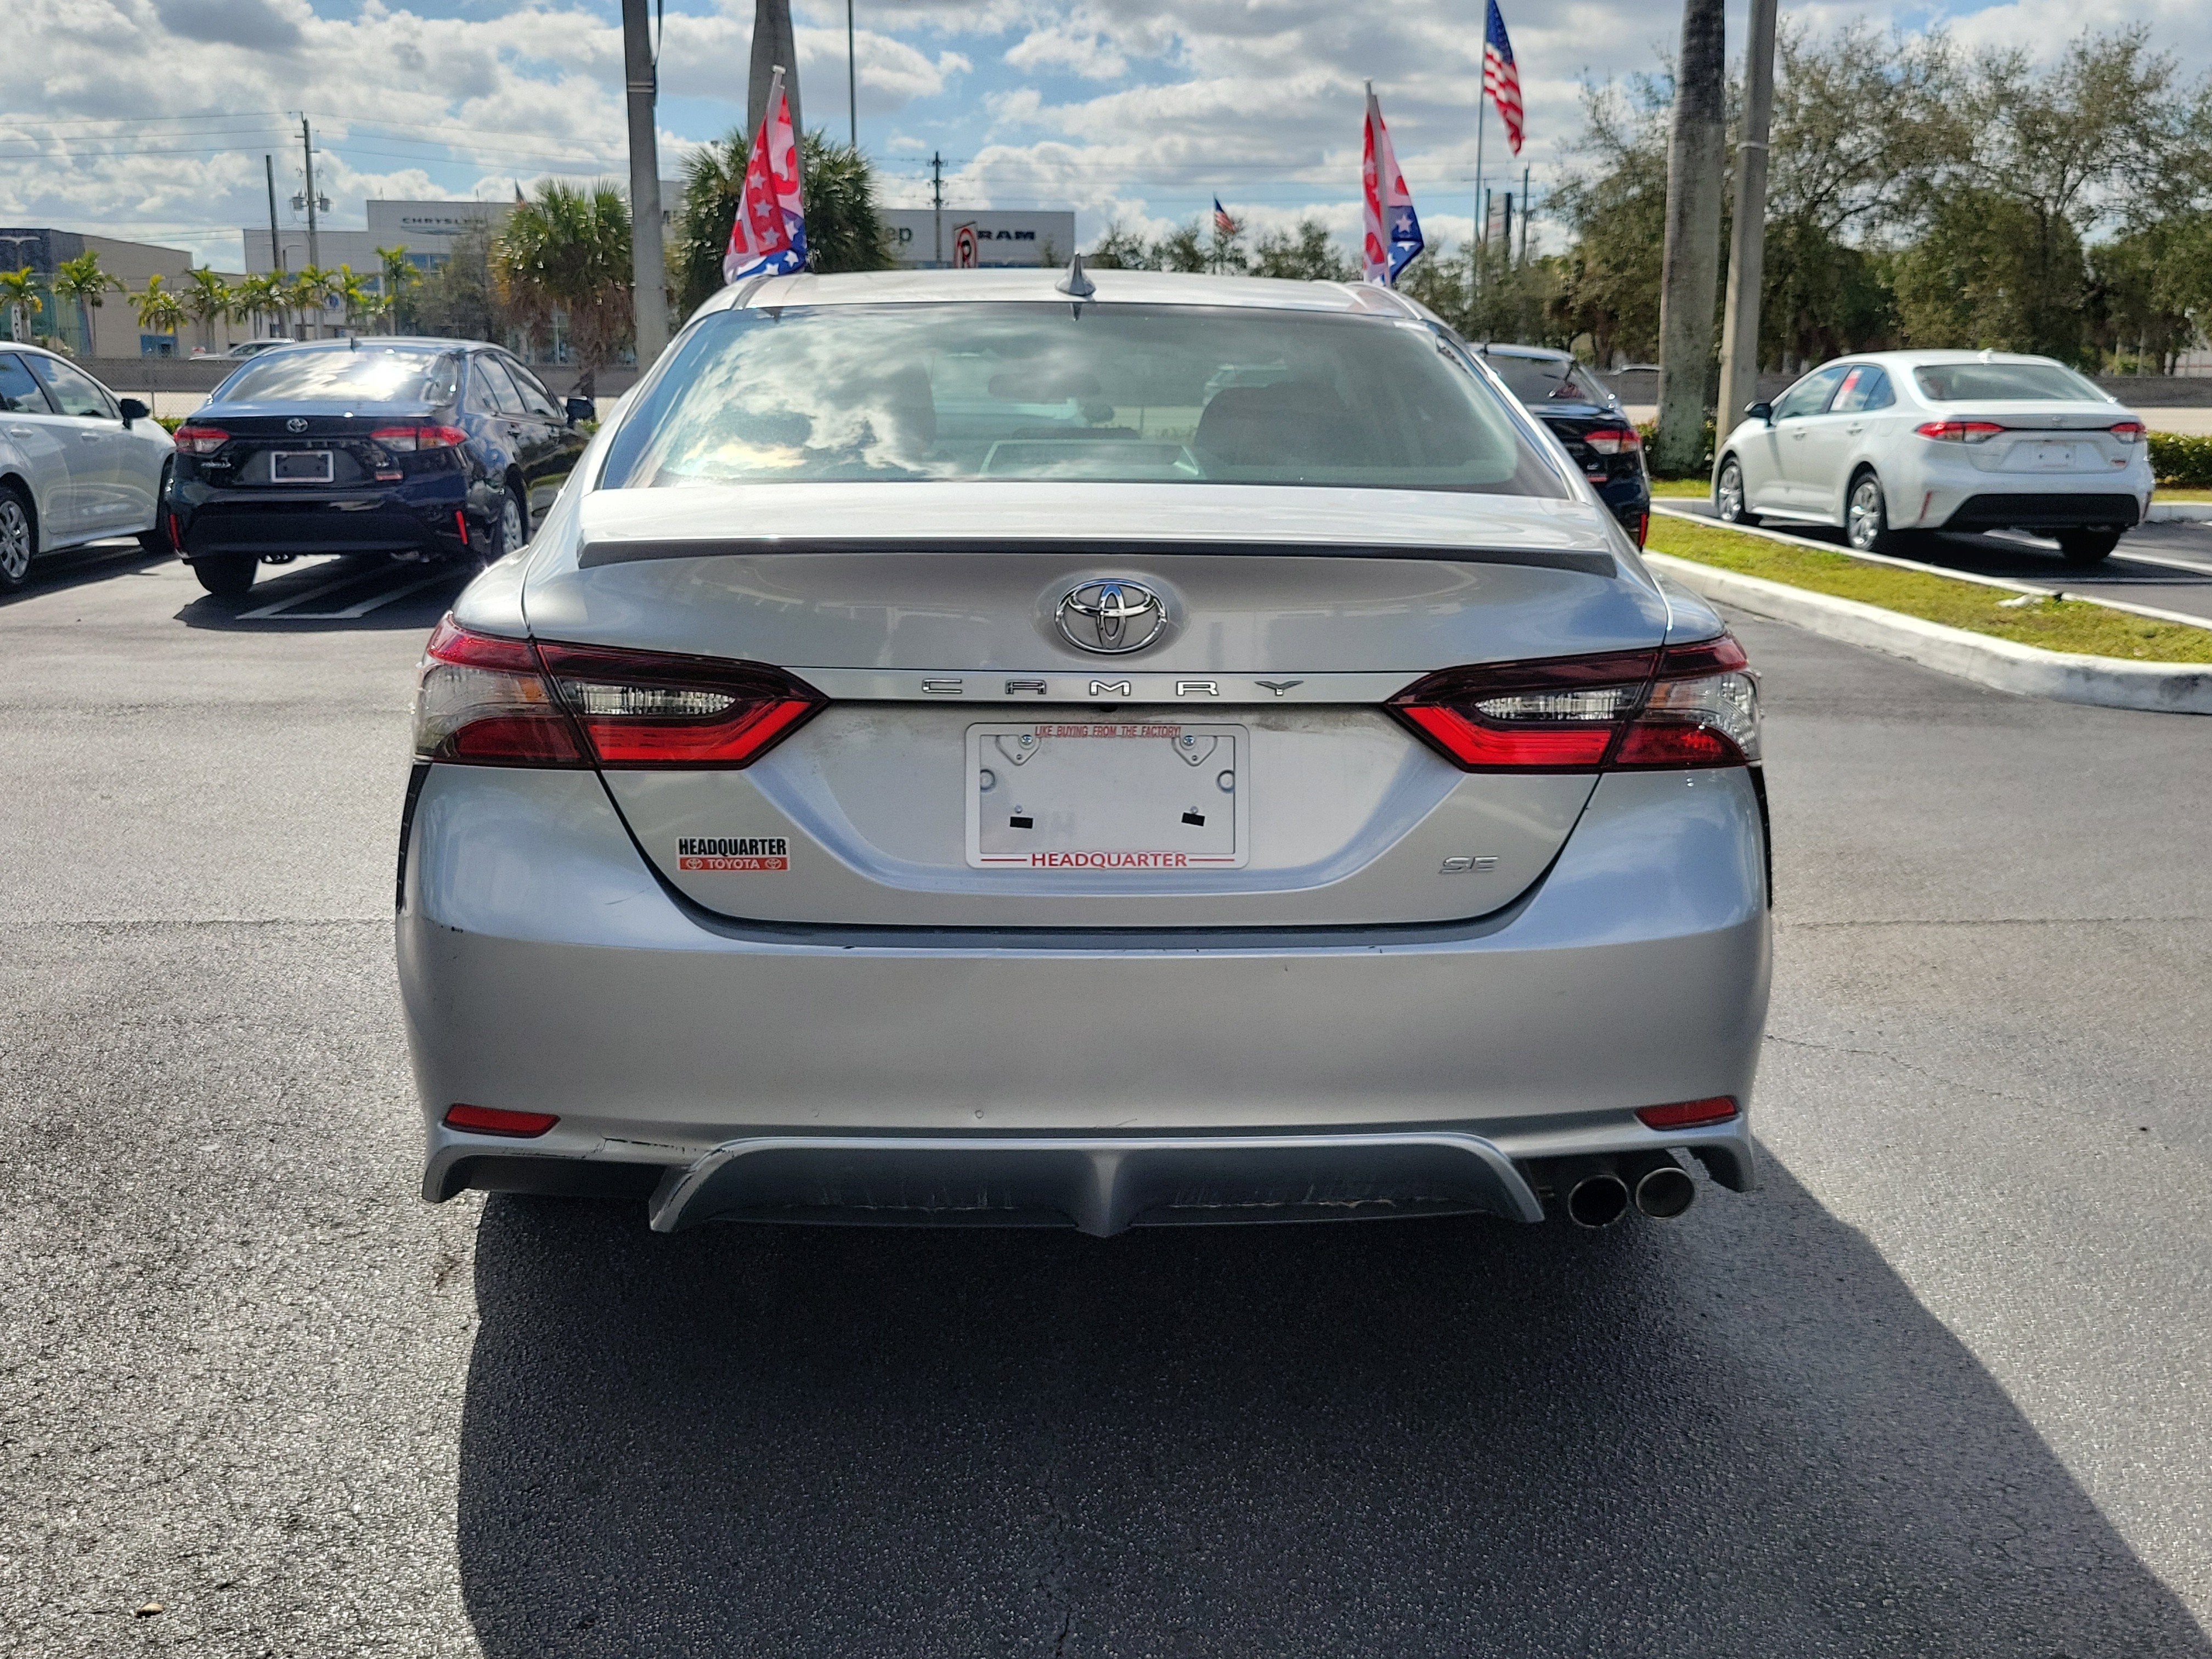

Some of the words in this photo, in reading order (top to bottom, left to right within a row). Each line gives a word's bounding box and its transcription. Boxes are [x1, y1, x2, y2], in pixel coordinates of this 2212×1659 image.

[977, 230, 1035, 240] RAM
[922, 679, 1304, 697] CAMRY
[1035, 726, 1052, 736] LIKE
[1057, 726, 1088, 737] BUYING
[1093, 726, 1117, 737] FROM
[1121, 726, 1137, 737] THE
[679, 838, 787, 856] HEADQUARTER
[708, 859, 760, 869] TOYOTA
[1031, 853, 1187, 867] HEADQUARTER
[1438, 856, 1499, 874] SE
